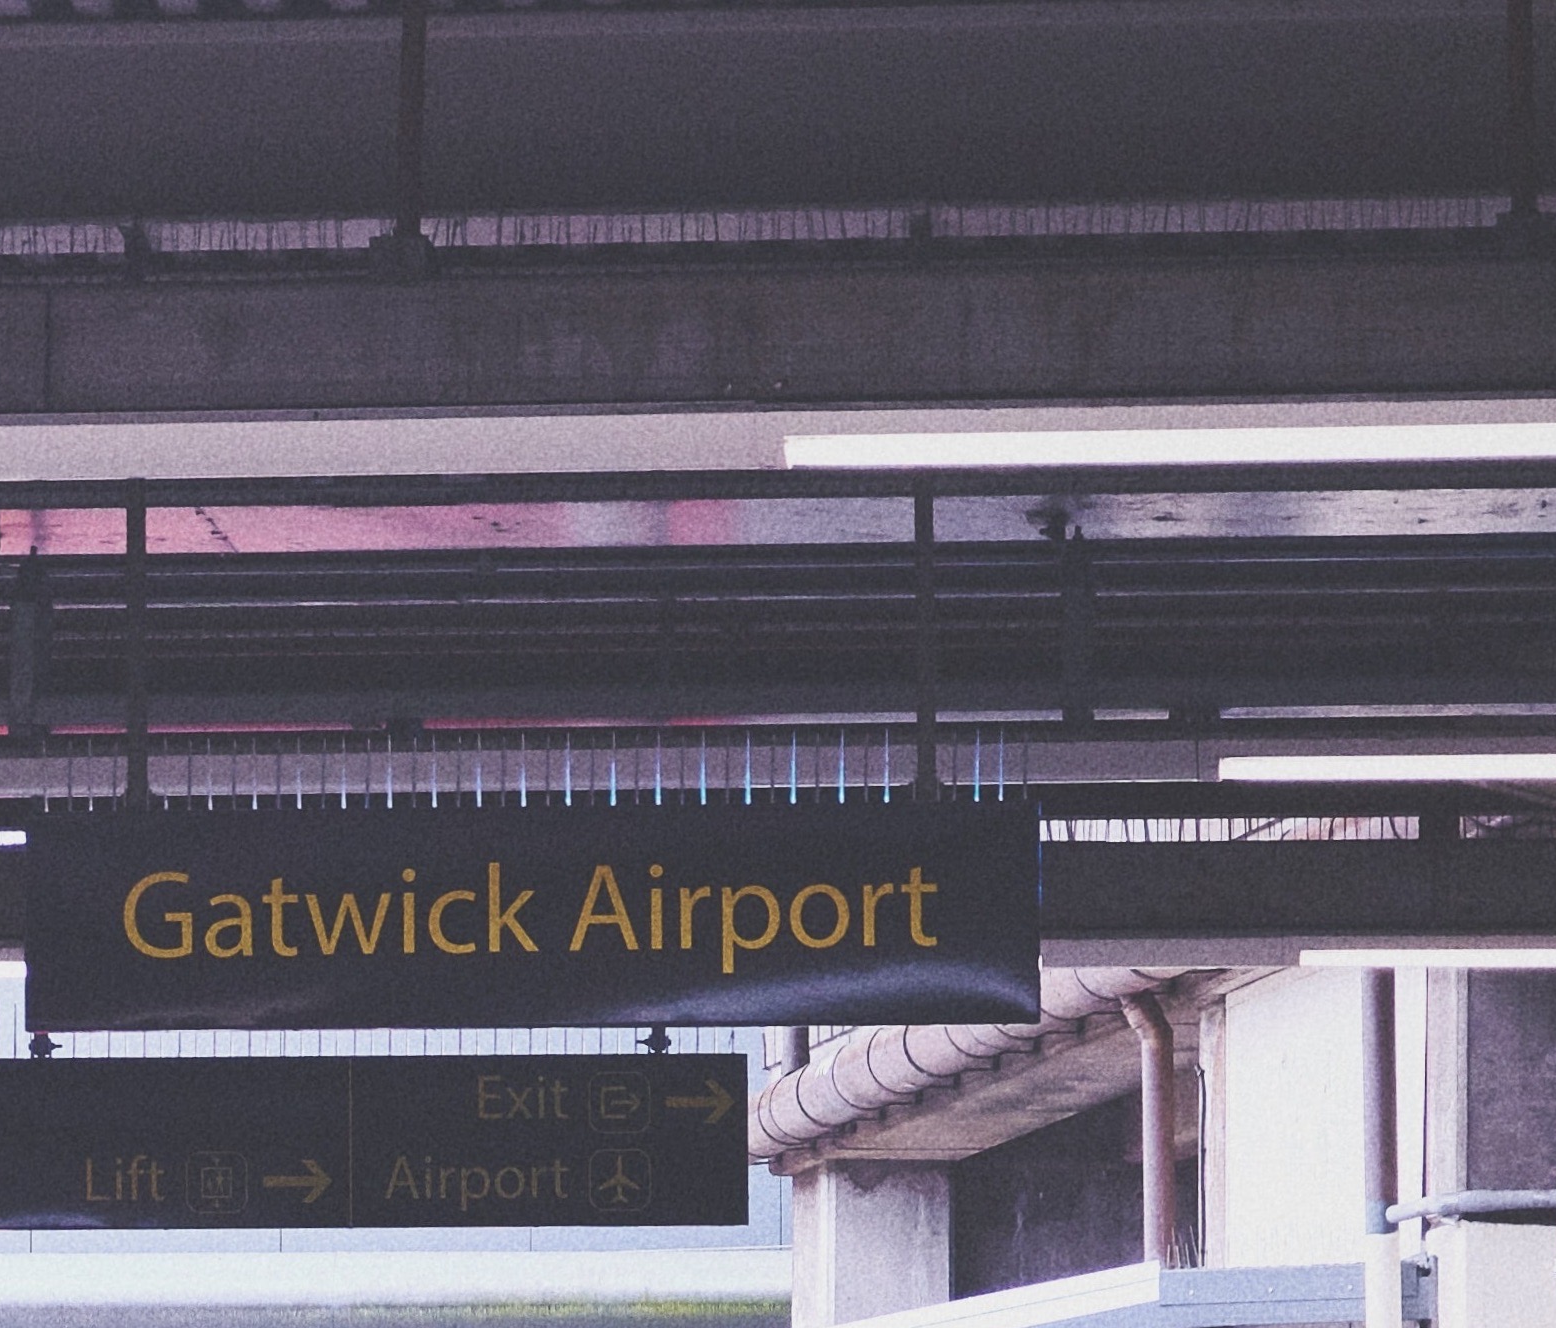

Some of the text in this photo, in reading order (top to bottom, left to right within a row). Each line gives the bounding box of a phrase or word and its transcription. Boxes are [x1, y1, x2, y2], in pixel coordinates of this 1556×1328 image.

[122, 861, 939, 975] Gatwick Airport
[476, 1075, 569, 1120] Exit
[84, 1155, 165, 1201] Lift
[384, 1155, 569, 1209] Airport
